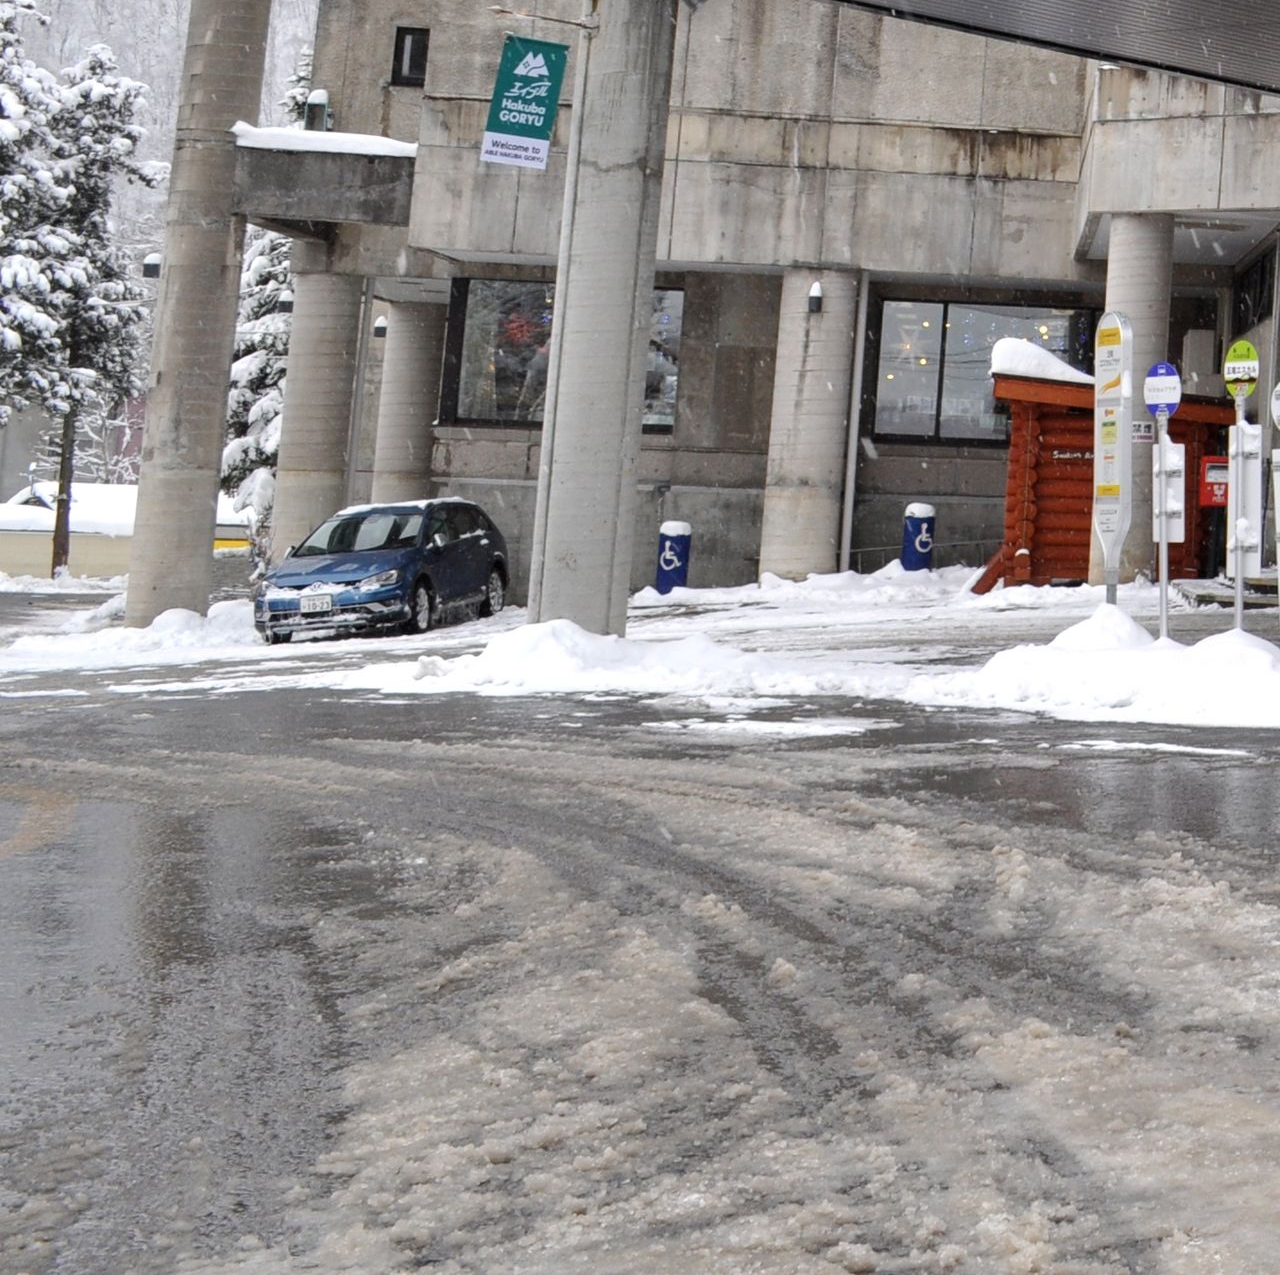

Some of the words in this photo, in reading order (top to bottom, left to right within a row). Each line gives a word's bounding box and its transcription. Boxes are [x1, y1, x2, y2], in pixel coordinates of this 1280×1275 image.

[501, 98, 546, 114] Hakuba
[499, 110, 544, 127] GORYU
[492, 139, 529, 153] Welcome
[532, 146, 541, 154] to
